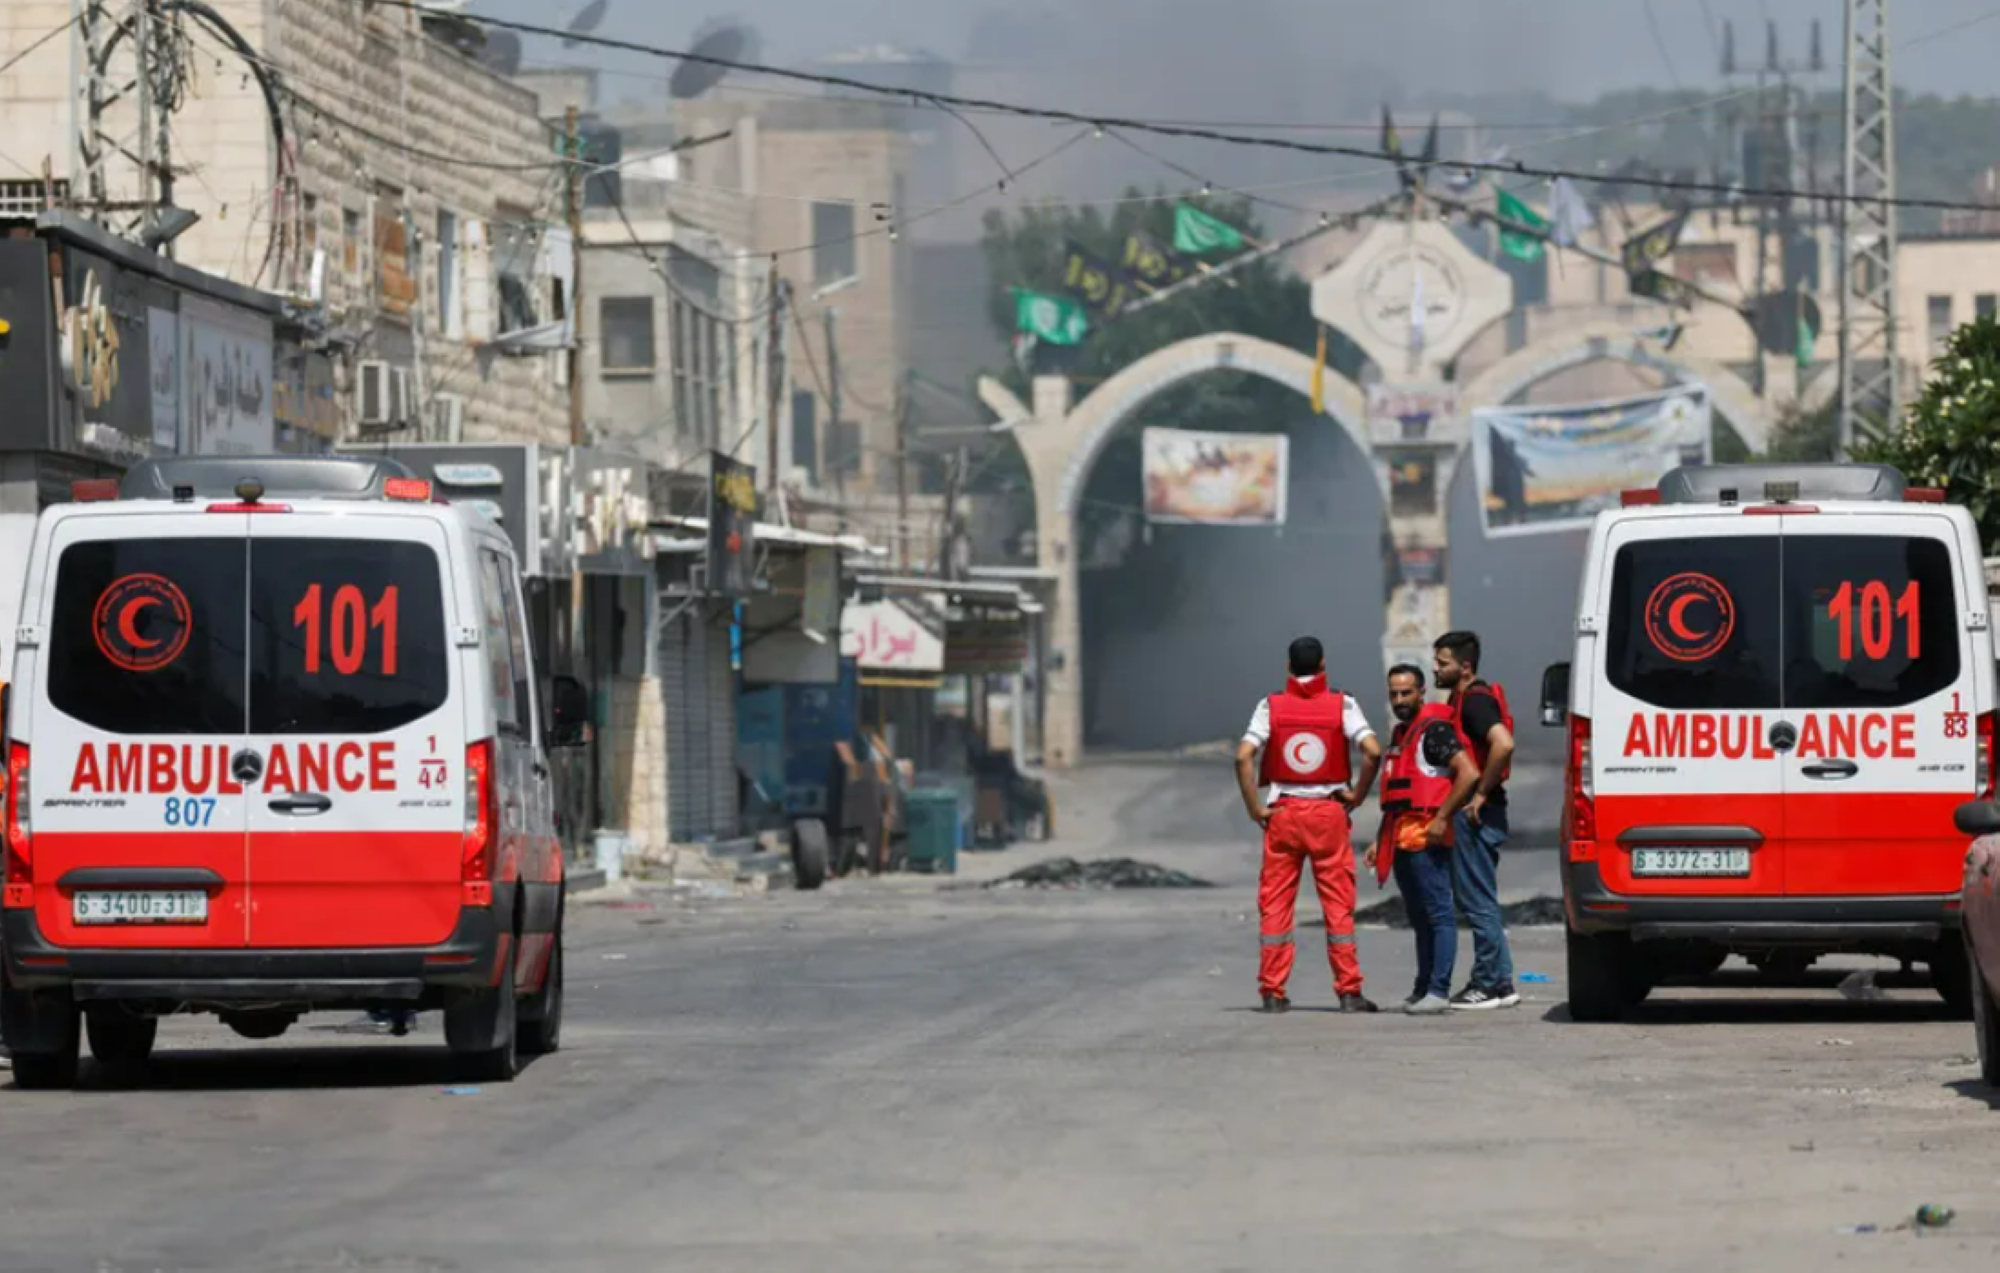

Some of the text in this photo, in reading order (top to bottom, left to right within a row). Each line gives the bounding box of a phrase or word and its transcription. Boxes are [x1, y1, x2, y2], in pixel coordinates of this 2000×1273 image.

[293, 583, 398, 675] 101
[1828, 580, 1920, 661] 101
[1623, 712, 1916, 759] AMBULANCE
[1943, 718, 1968, 738] 83
[70, 741, 398, 794] AMBULANCE
[164, 797, 217, 827] 807
